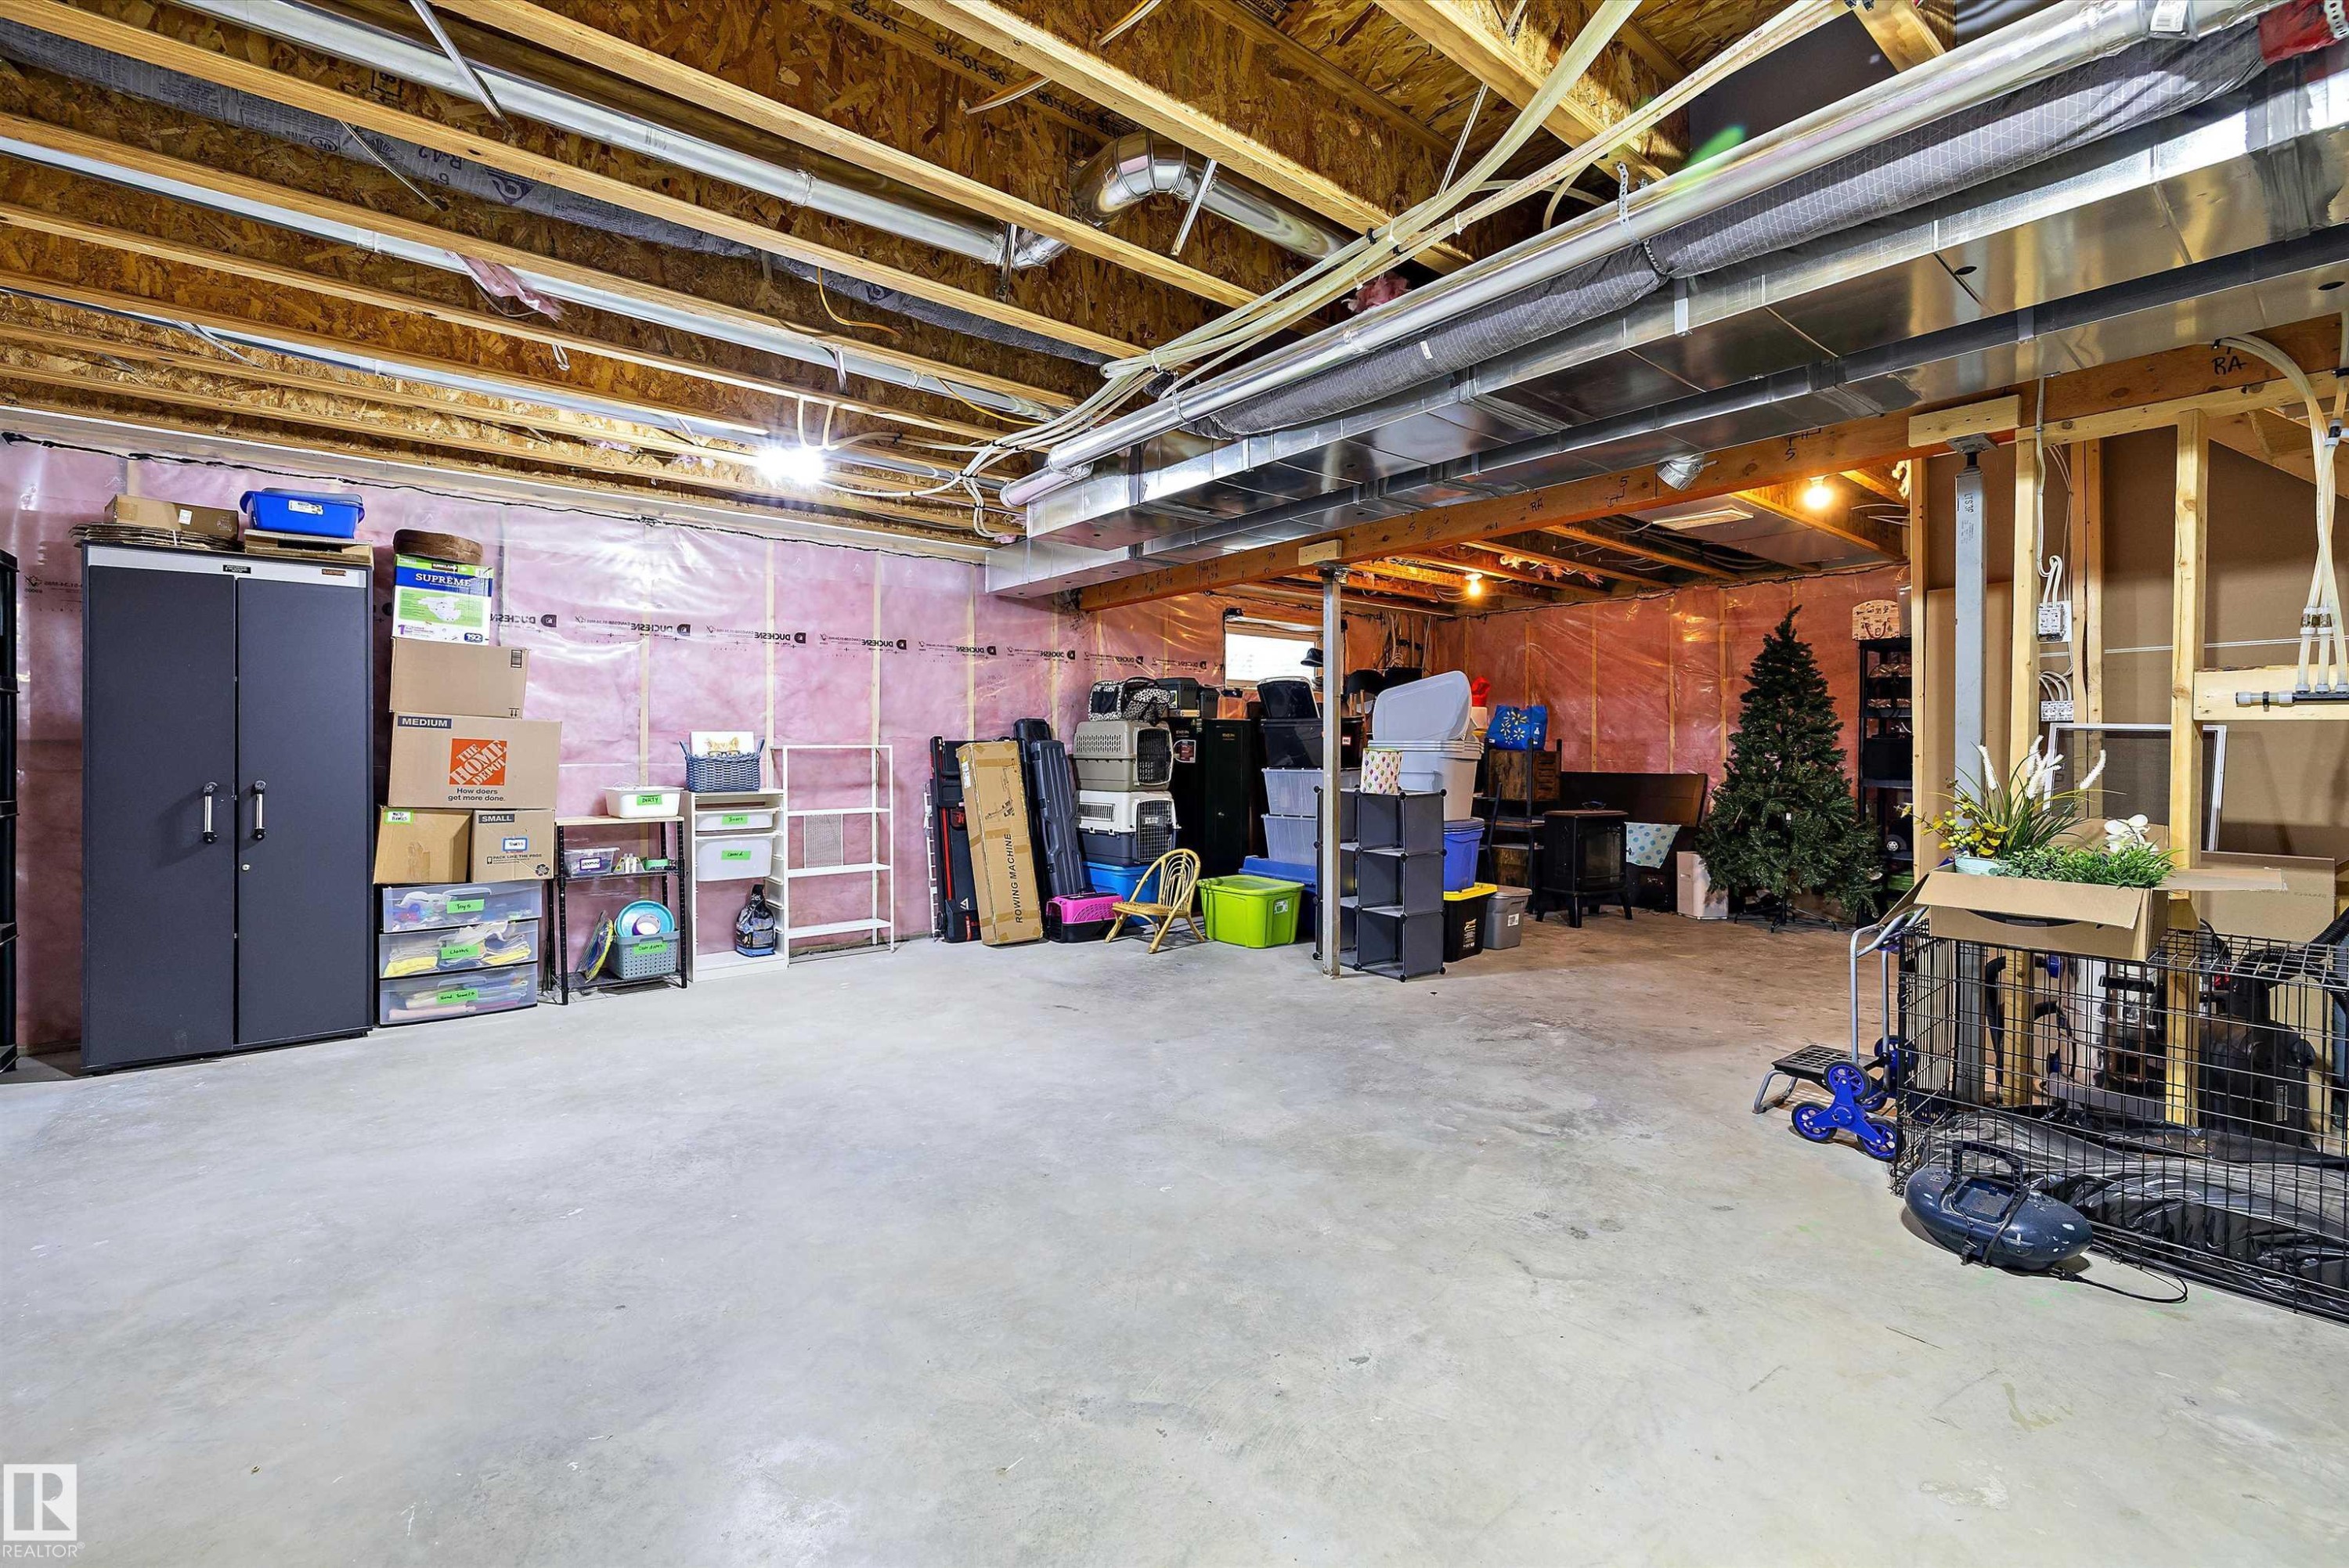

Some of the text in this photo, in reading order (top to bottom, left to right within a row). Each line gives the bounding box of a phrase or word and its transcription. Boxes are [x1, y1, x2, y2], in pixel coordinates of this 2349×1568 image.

[2211, 355, 2247, 376] RA
[402, 718, 448, 727] MEDIUM
[449, 740, 507, 785] HOME
[456, 743, 481, 762] THE
[471, 756, 507, 785] DEPOT
[1005, 833, 1023, 924] ROWING MACHINE
